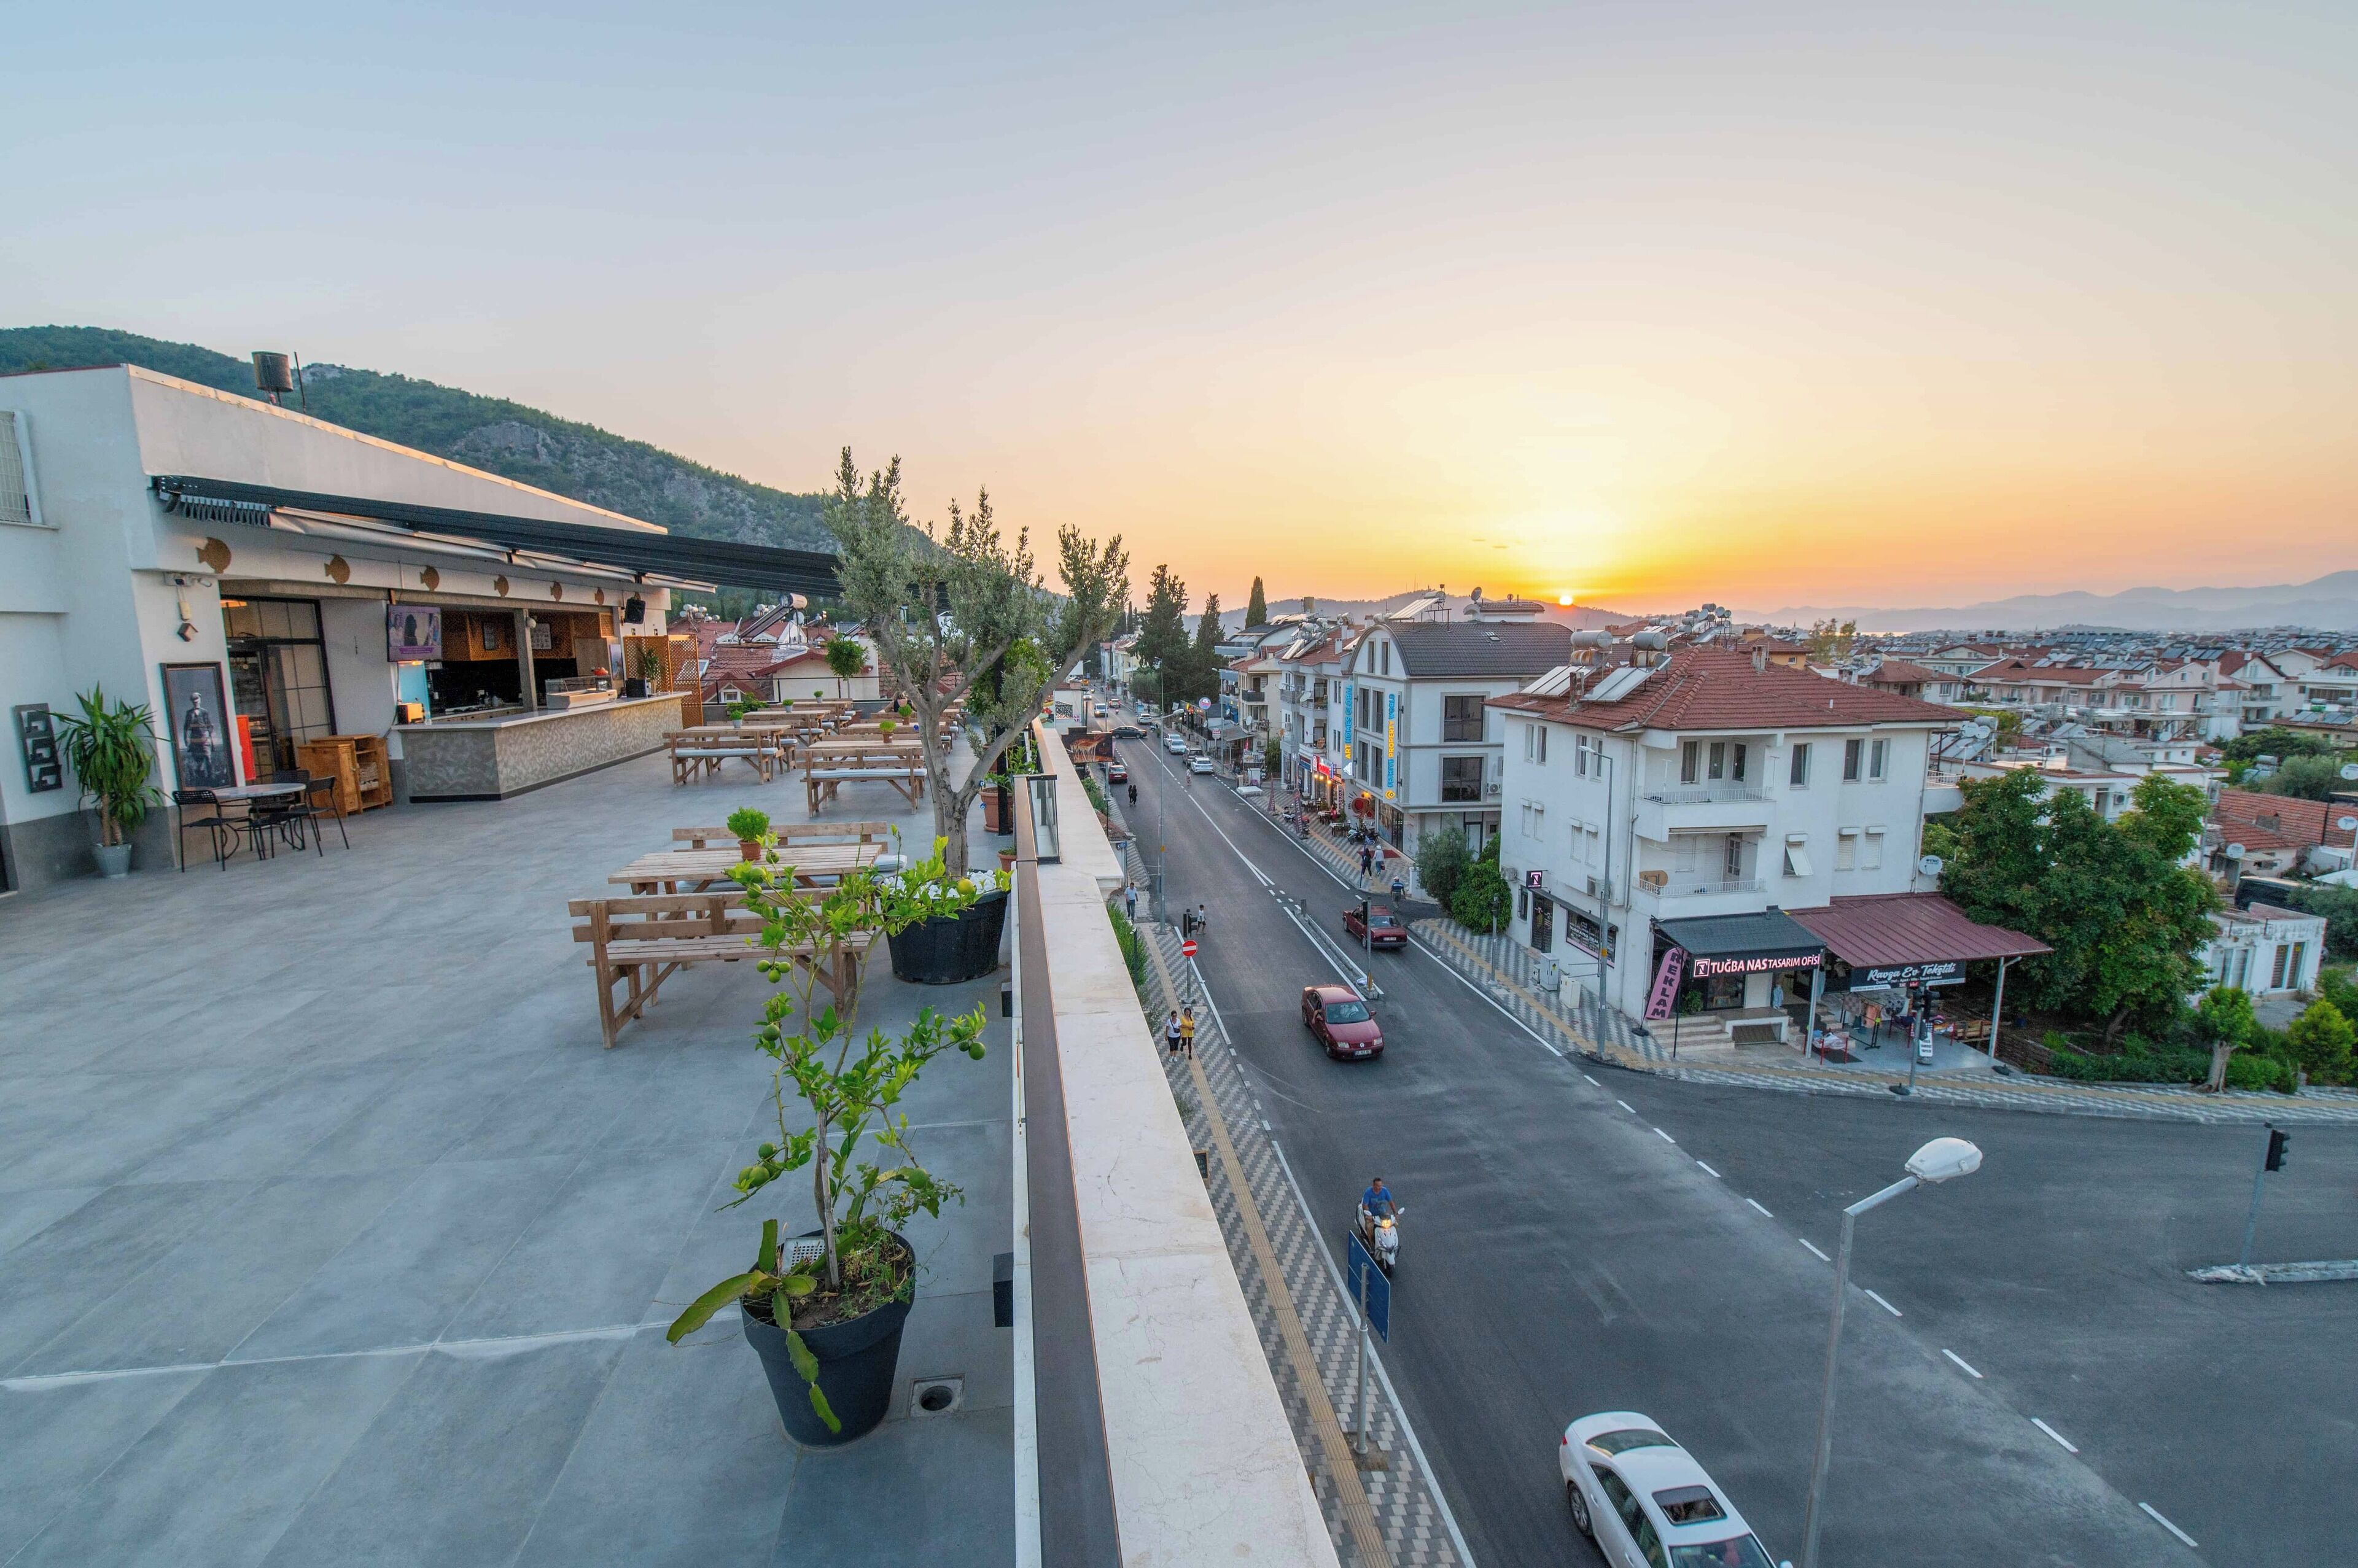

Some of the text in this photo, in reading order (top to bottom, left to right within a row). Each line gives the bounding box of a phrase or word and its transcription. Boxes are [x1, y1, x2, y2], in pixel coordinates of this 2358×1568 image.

[1711, 954, 1821, 974] TUĞBA NAS TASARIM OFİSİ
[1867, 963, 1956, 981] Ravza Ev Tekstili
[1651, 952, 1681, 1018] REKLAM
